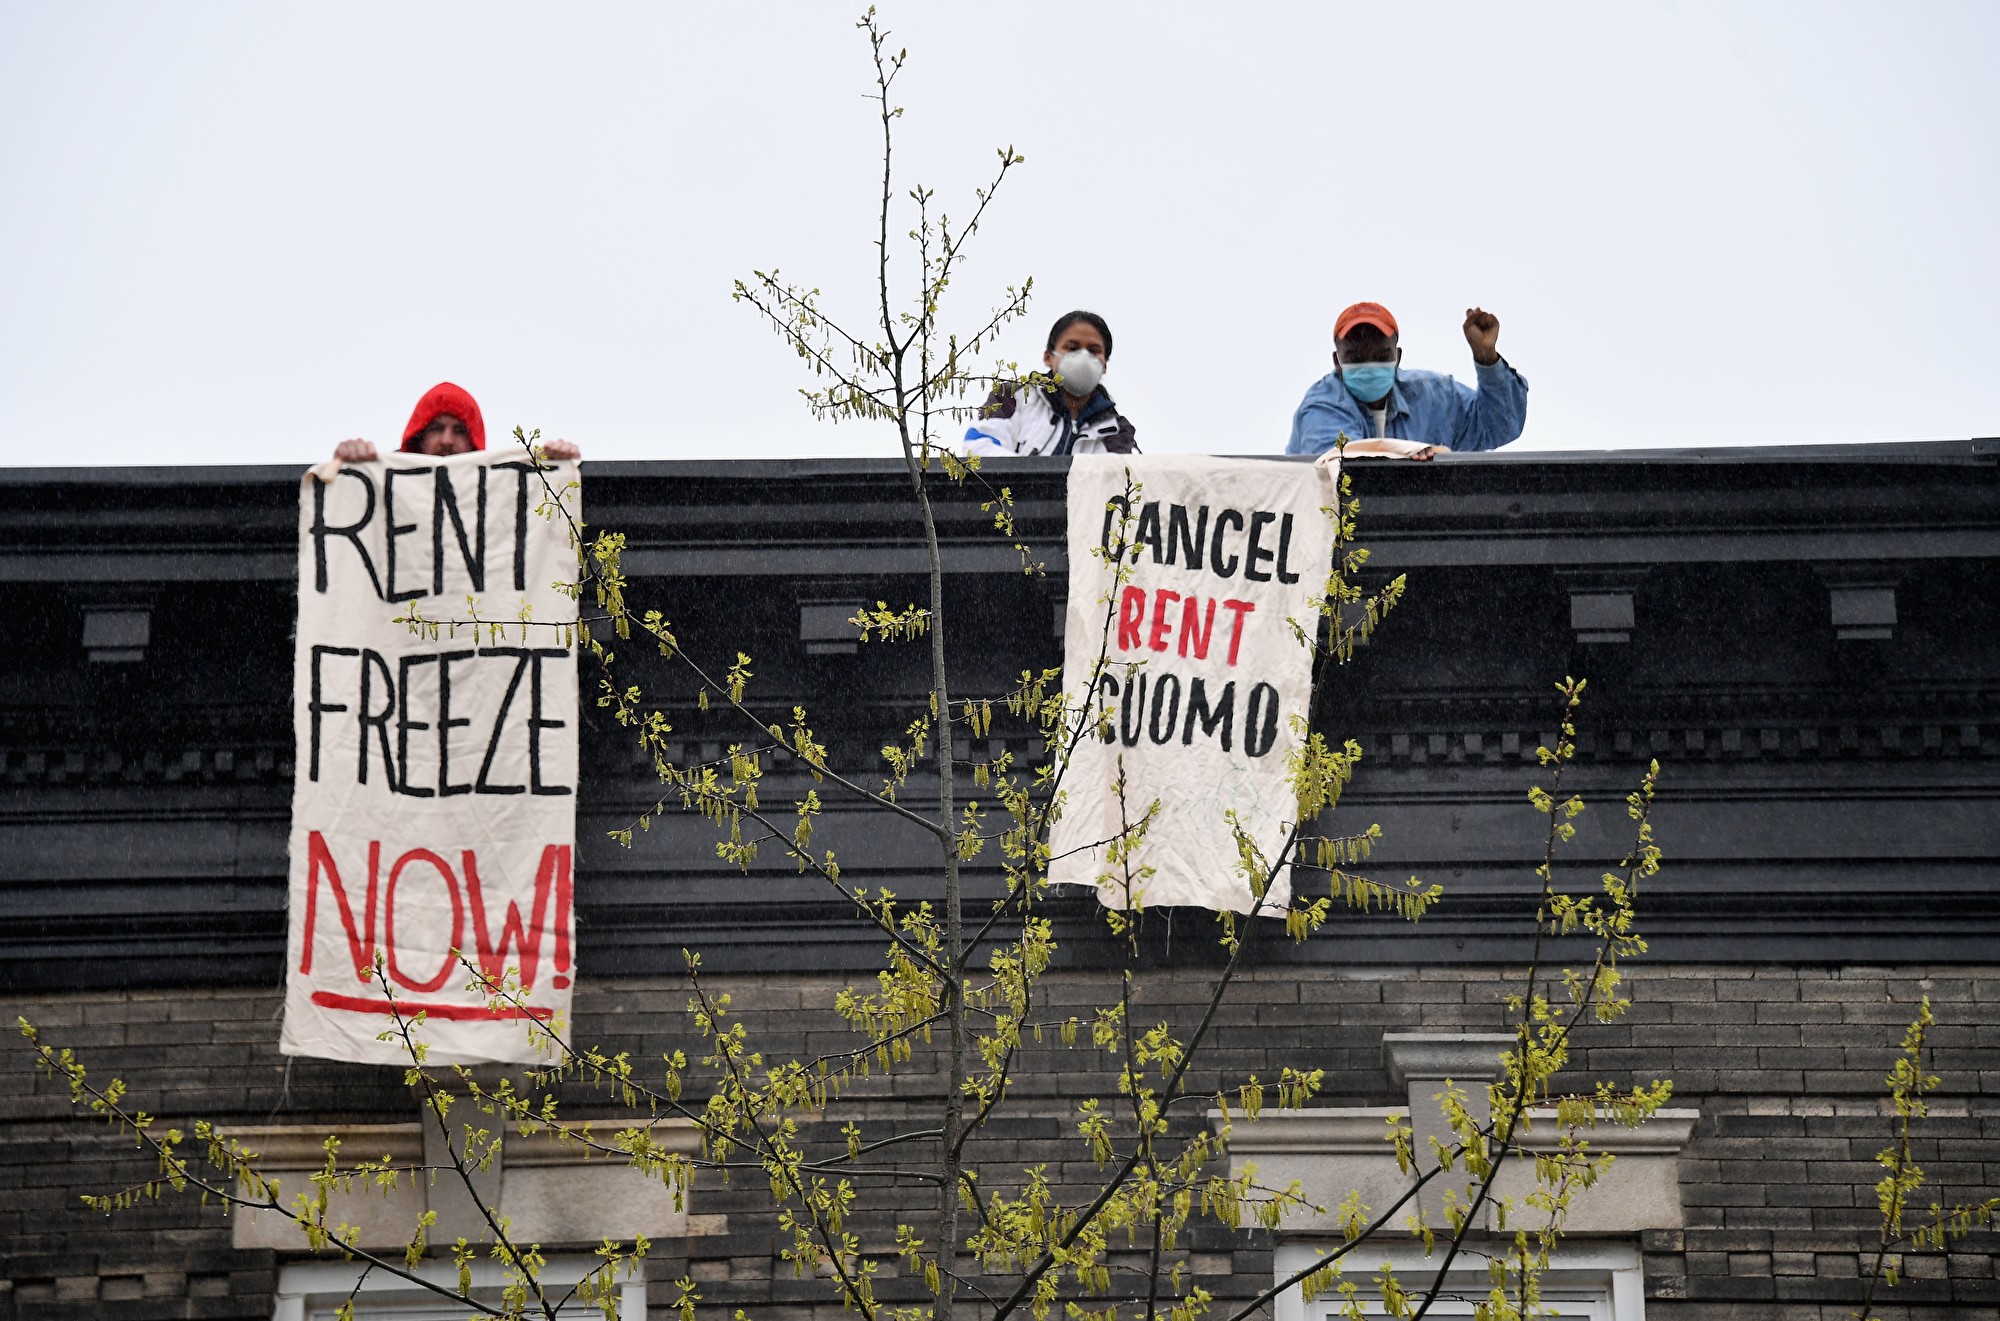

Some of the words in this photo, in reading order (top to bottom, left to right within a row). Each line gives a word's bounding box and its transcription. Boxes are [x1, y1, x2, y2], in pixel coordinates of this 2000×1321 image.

[310, 461, 559, 603] RENT
[1101, 495, 1300, 584] CANCEL
[1117, 585, 1255, 667] RENT
[309, 645, 572, 797] FREEZE
[1099, 672, 1279, 757] CUOMO
[300, 830, 573, 994] NOW!
